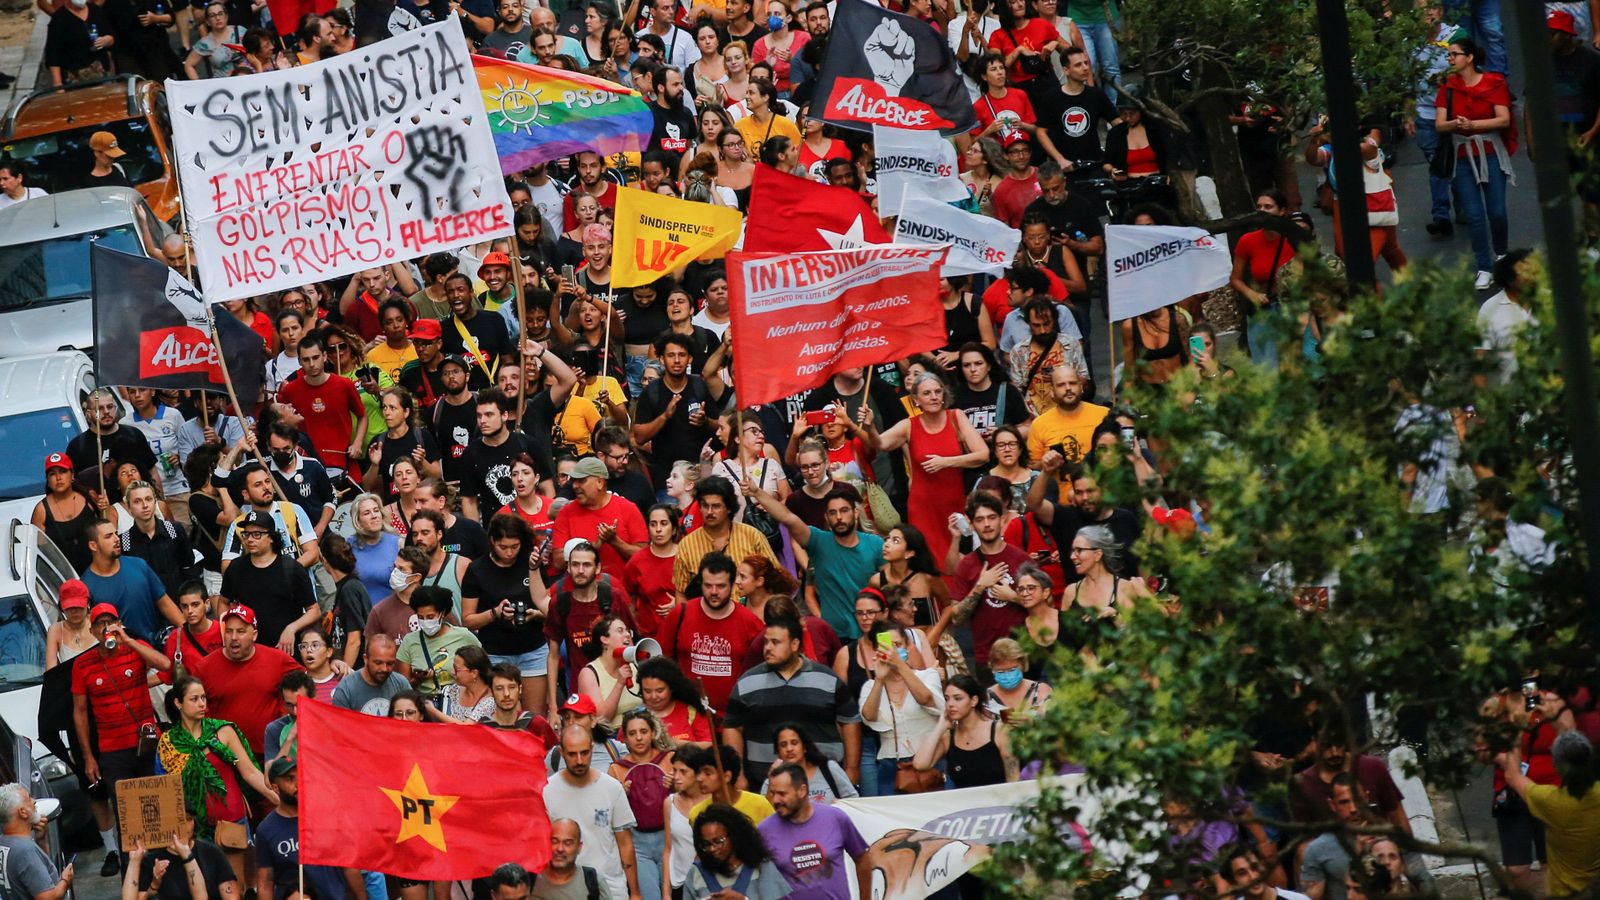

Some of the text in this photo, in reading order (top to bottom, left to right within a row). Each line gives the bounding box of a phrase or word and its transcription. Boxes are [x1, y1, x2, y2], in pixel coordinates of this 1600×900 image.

[561, 90, 620, 109] PSOL
[203, 82, 300, 157] SEM
[209, 130, 406, 213] ENFRENTAR O
[636, 238, 690, 272] LUT
[668, 233, 680, 242] NA
[221, 245, 276, 288] NAS
[766, 320, 827, 339] Nenhum
[865, 294, 911, 313] menos.
[401, 795, 435, 825] PT
